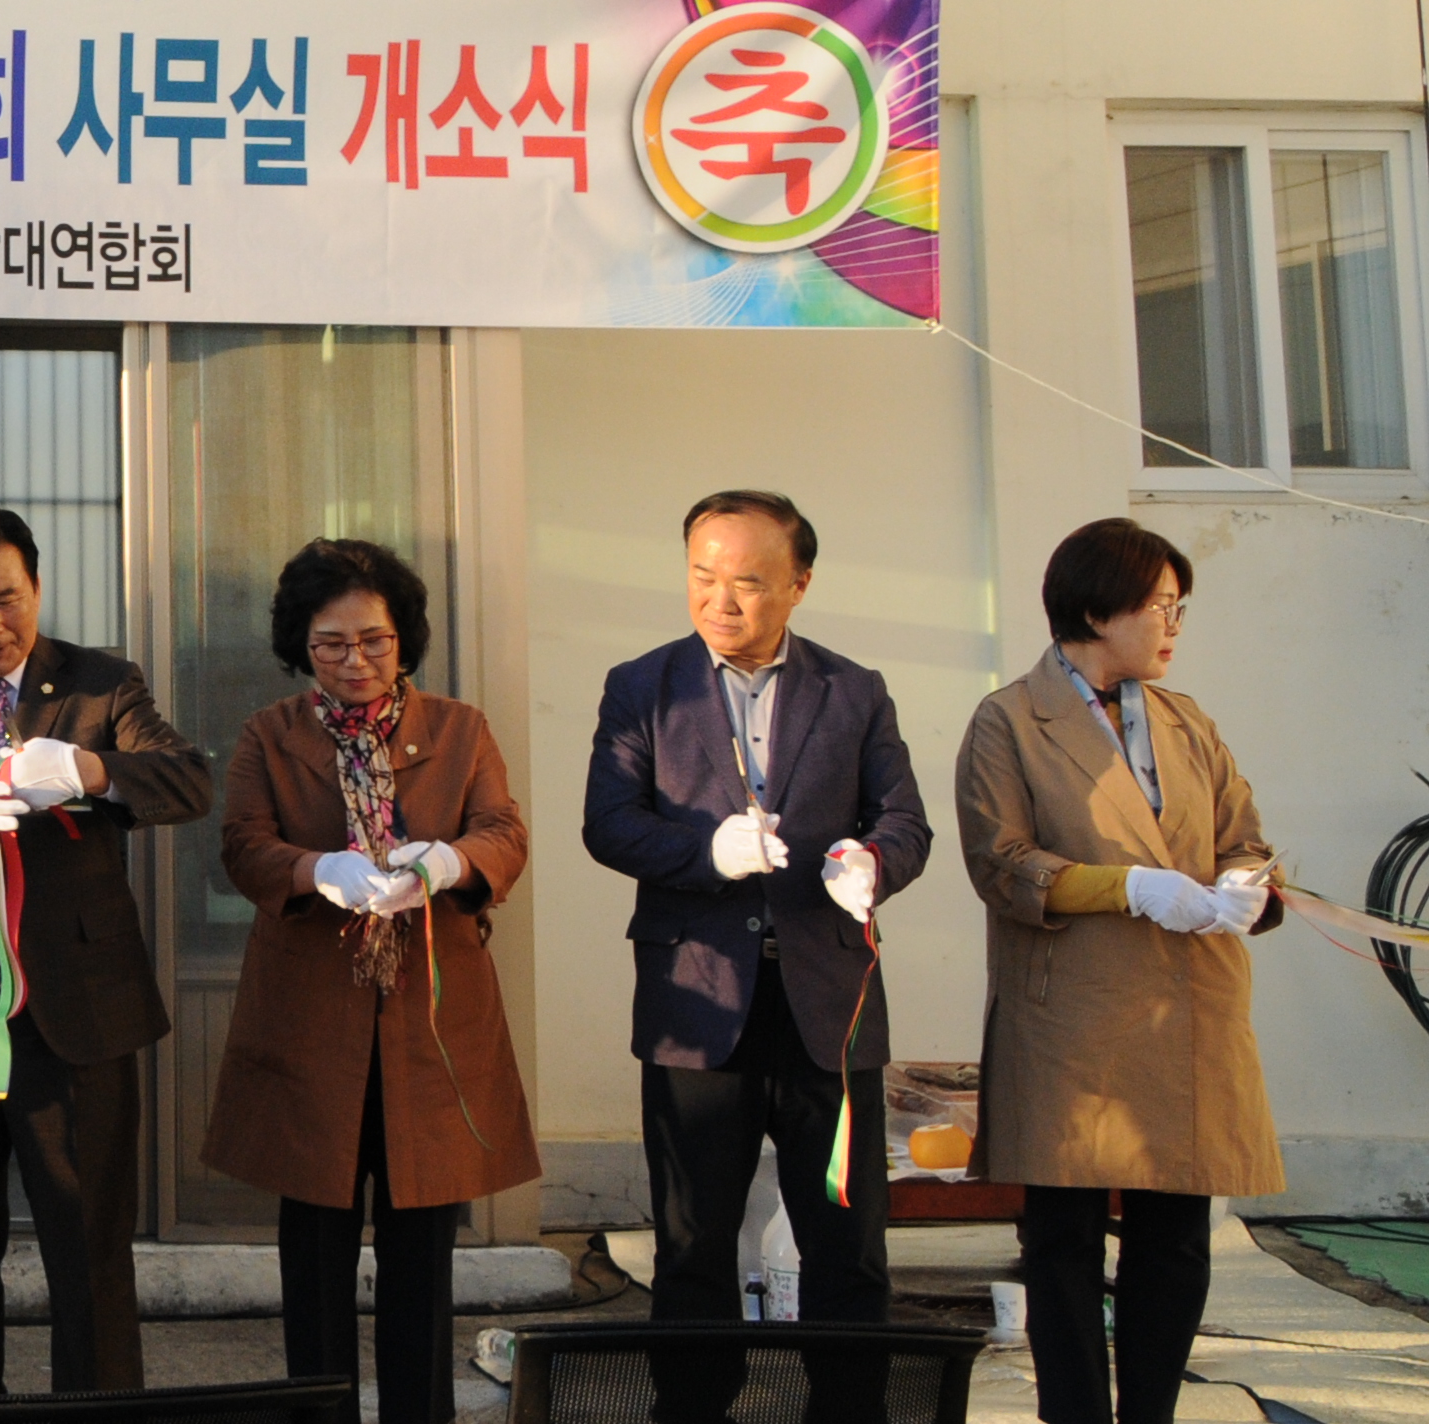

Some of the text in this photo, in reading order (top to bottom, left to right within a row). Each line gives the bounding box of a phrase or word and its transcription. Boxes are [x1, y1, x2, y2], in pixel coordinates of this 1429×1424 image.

[57, 33, 308, 185] 사무실
[341, 39, 589, 193] 개소식
[671, 49, 847, 216] 축
